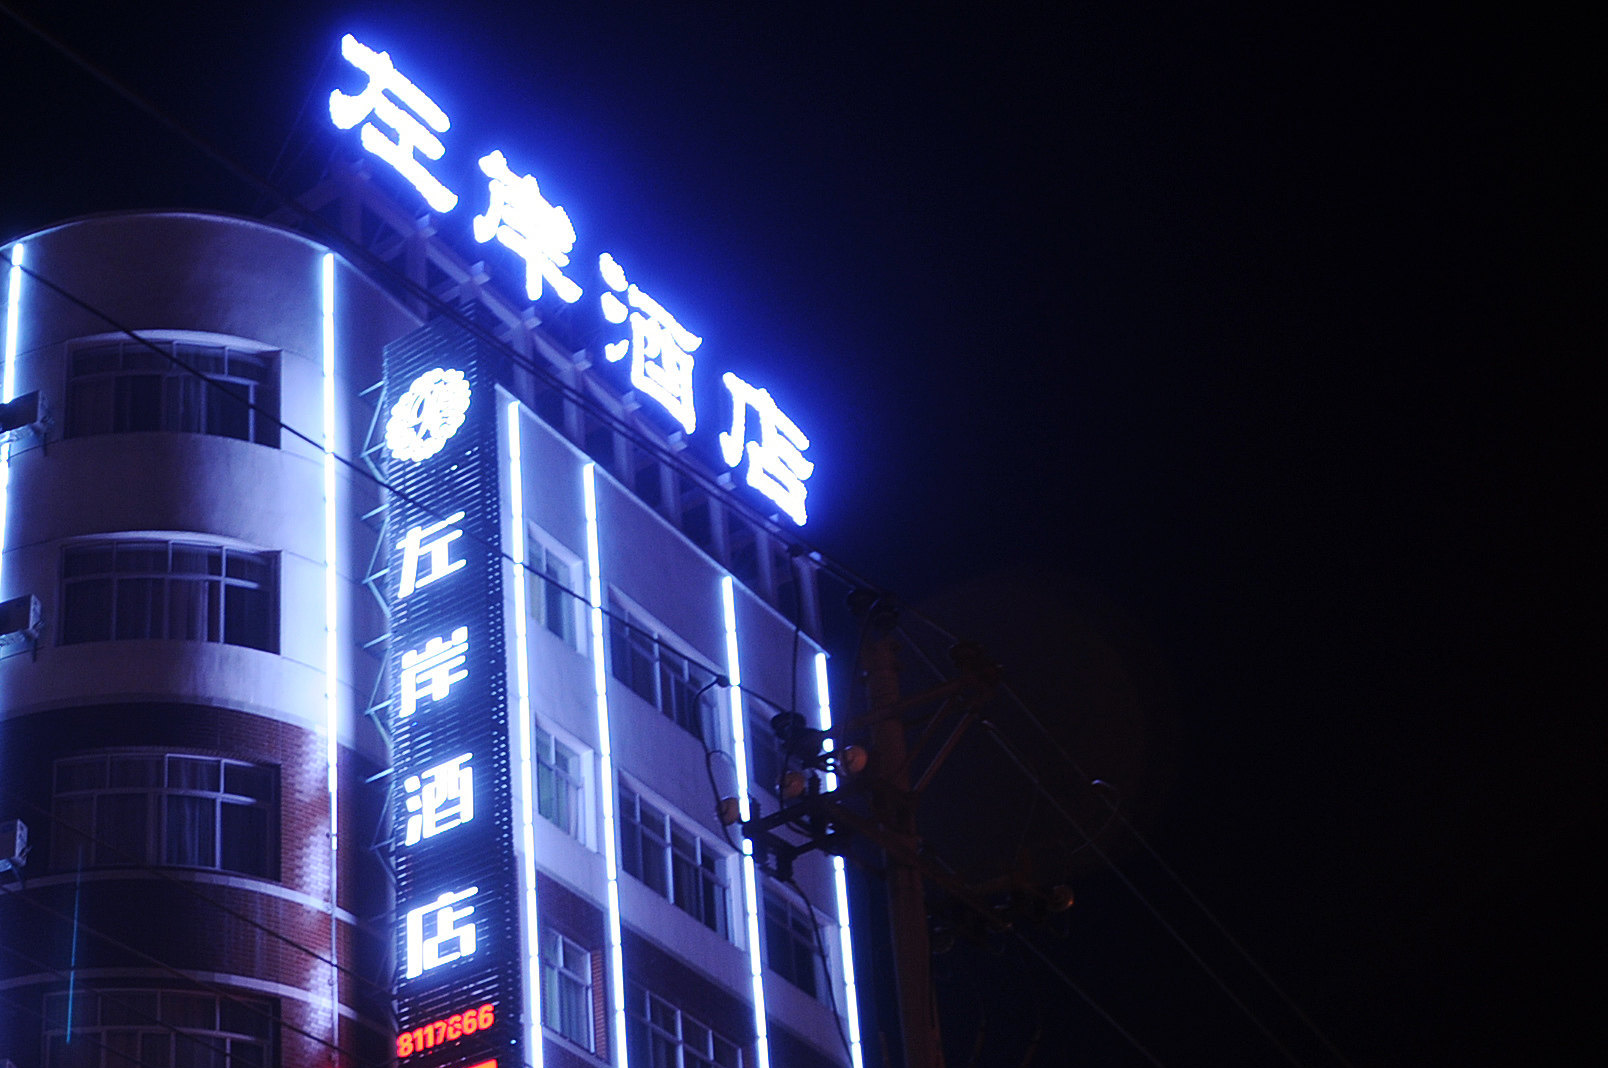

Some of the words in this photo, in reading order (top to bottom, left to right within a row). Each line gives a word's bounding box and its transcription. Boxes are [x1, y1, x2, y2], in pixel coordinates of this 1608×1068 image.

[329, 33, 814, 526] 左岸酒店
[396, 511, 479, 981] 左岸酒店
